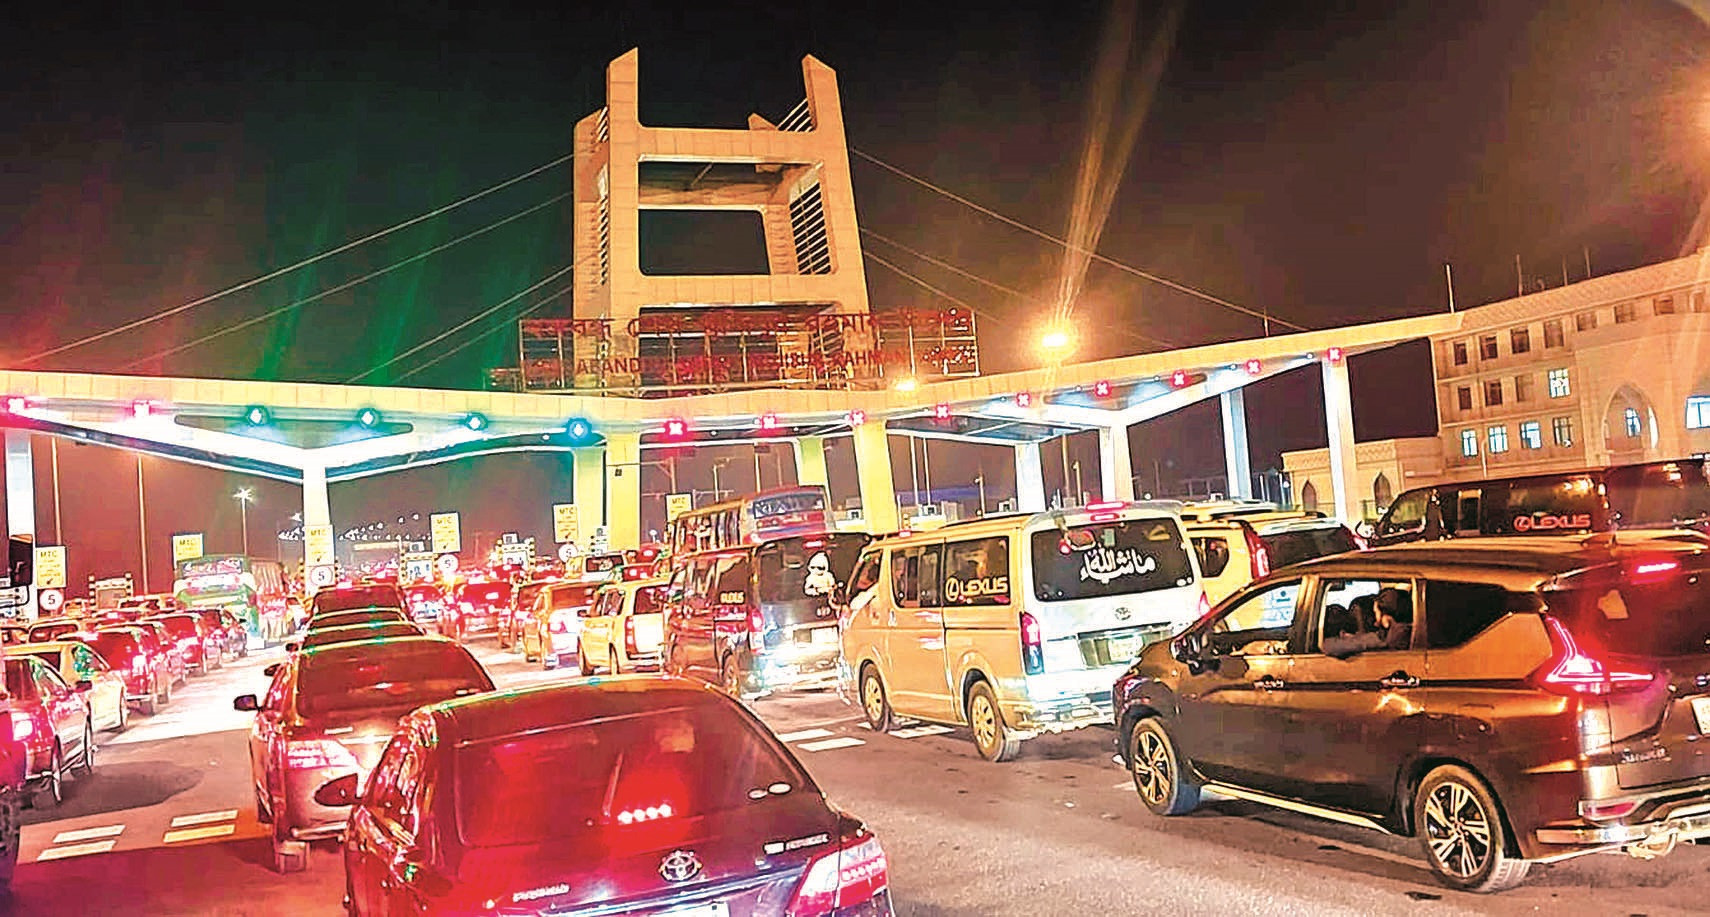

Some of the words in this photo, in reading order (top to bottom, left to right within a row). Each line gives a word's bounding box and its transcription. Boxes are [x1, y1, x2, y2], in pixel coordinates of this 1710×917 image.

[1531, 514, 1591, 530] LEXUS
[318, 570, 326, 582] 5
[959, 576, 1008, 598] LEXUS
[47, 594, 57, 605] 5
